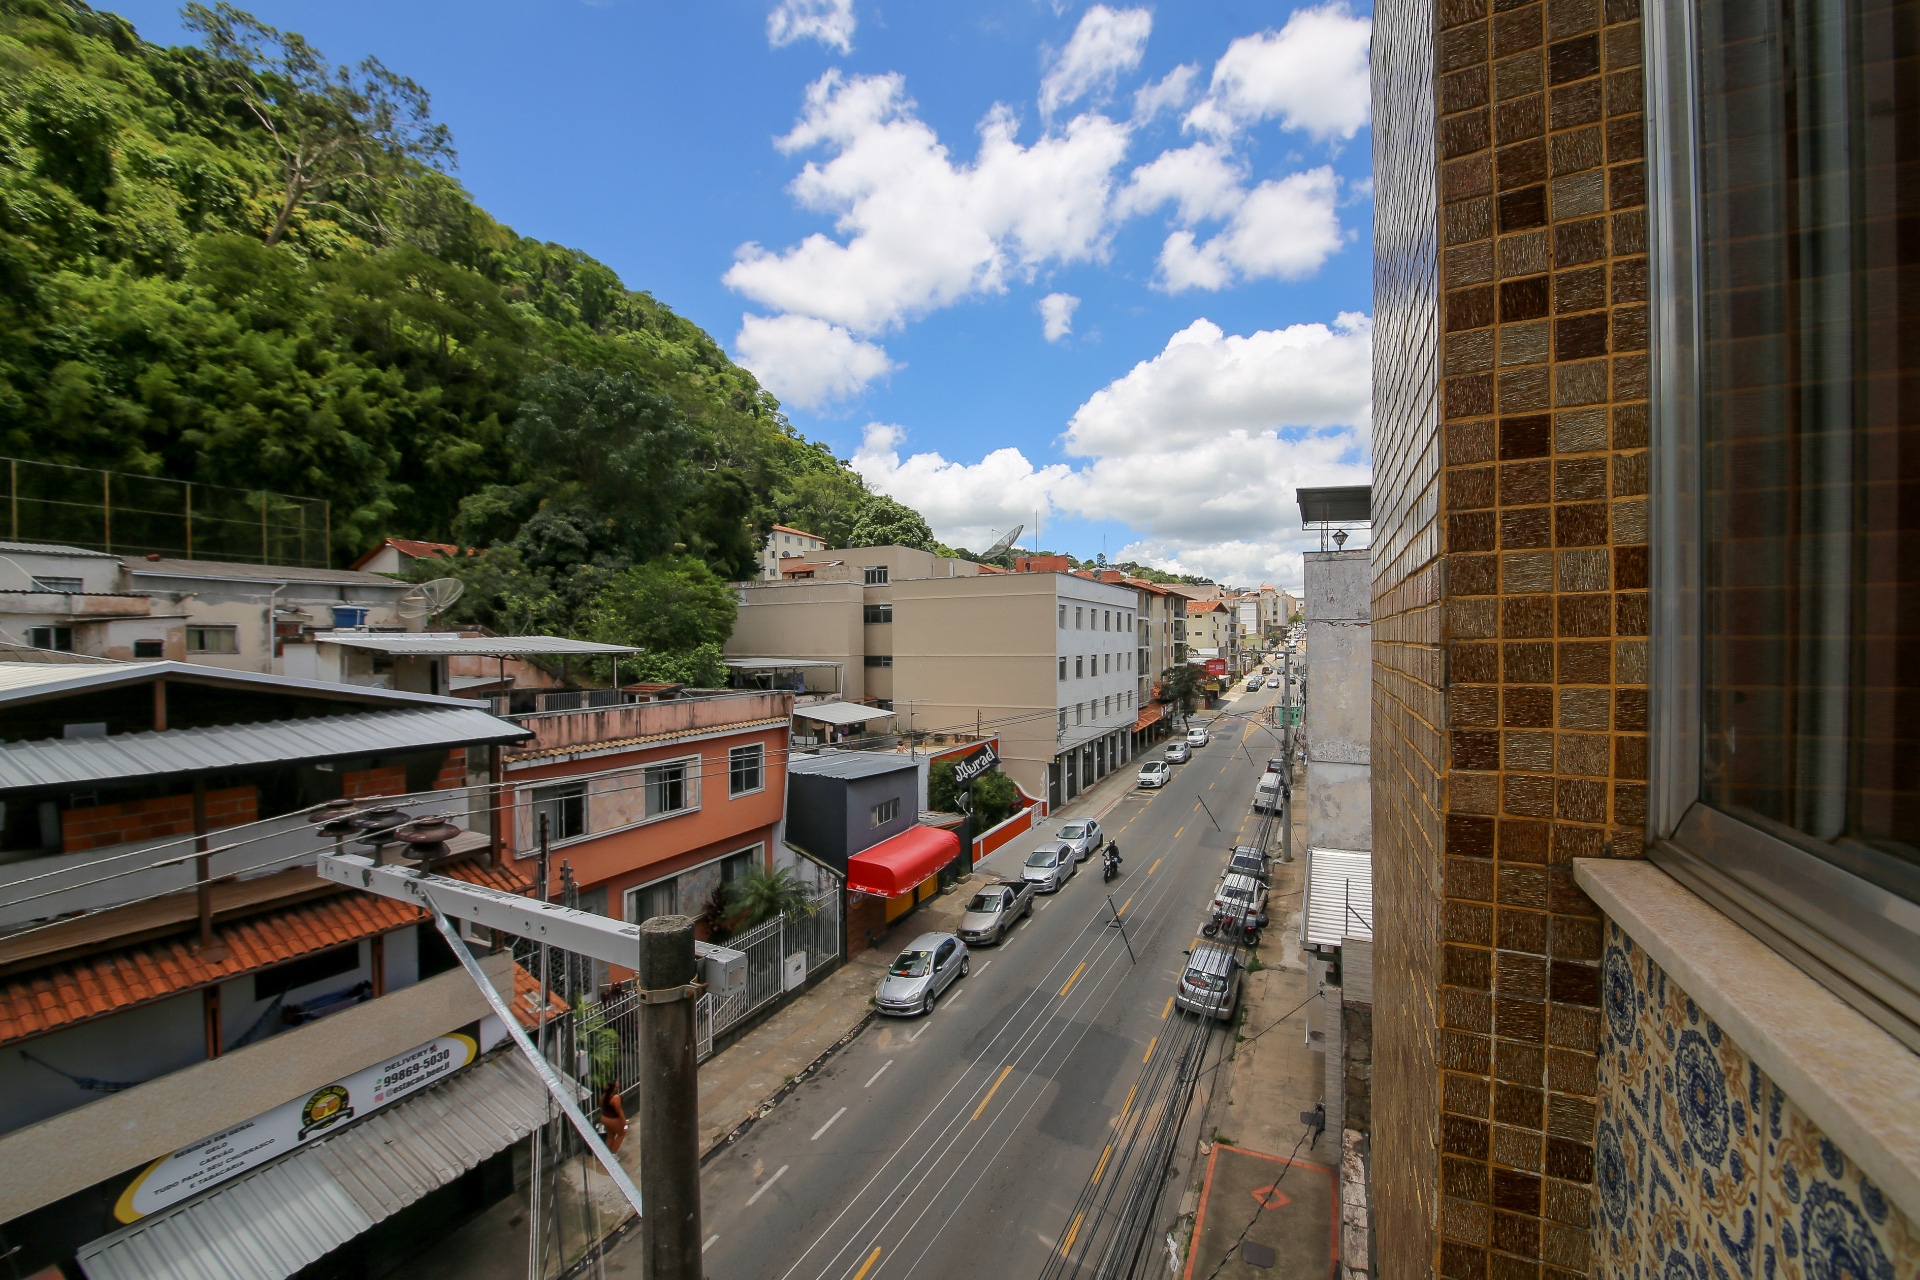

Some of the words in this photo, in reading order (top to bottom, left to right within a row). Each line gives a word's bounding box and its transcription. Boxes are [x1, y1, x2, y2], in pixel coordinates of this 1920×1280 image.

[954, 744, 996, 782] Murad
[384, 1048, 450, 1087] 99869-5030
[385, 1047, 429, 1072] DELIVERY
[174, 1139, 212, 1159] BEBIDAS
[214, 1133, 228, 1143] EM
[228, 1121, 256, 1136] GERAL
[205, 1141, 228, 1155] GELO
[153, 1181, 180, 1195] TUDO
[181, 1170, 205, 1183] PARA
[206, 1161, 225, 1173] SEU
[226, 1138, 276, 1164] CHURRASCO
[199, 1147, 235, 1166] CARVÃO
[197, 1160, 246, 1185] TABACARIA
